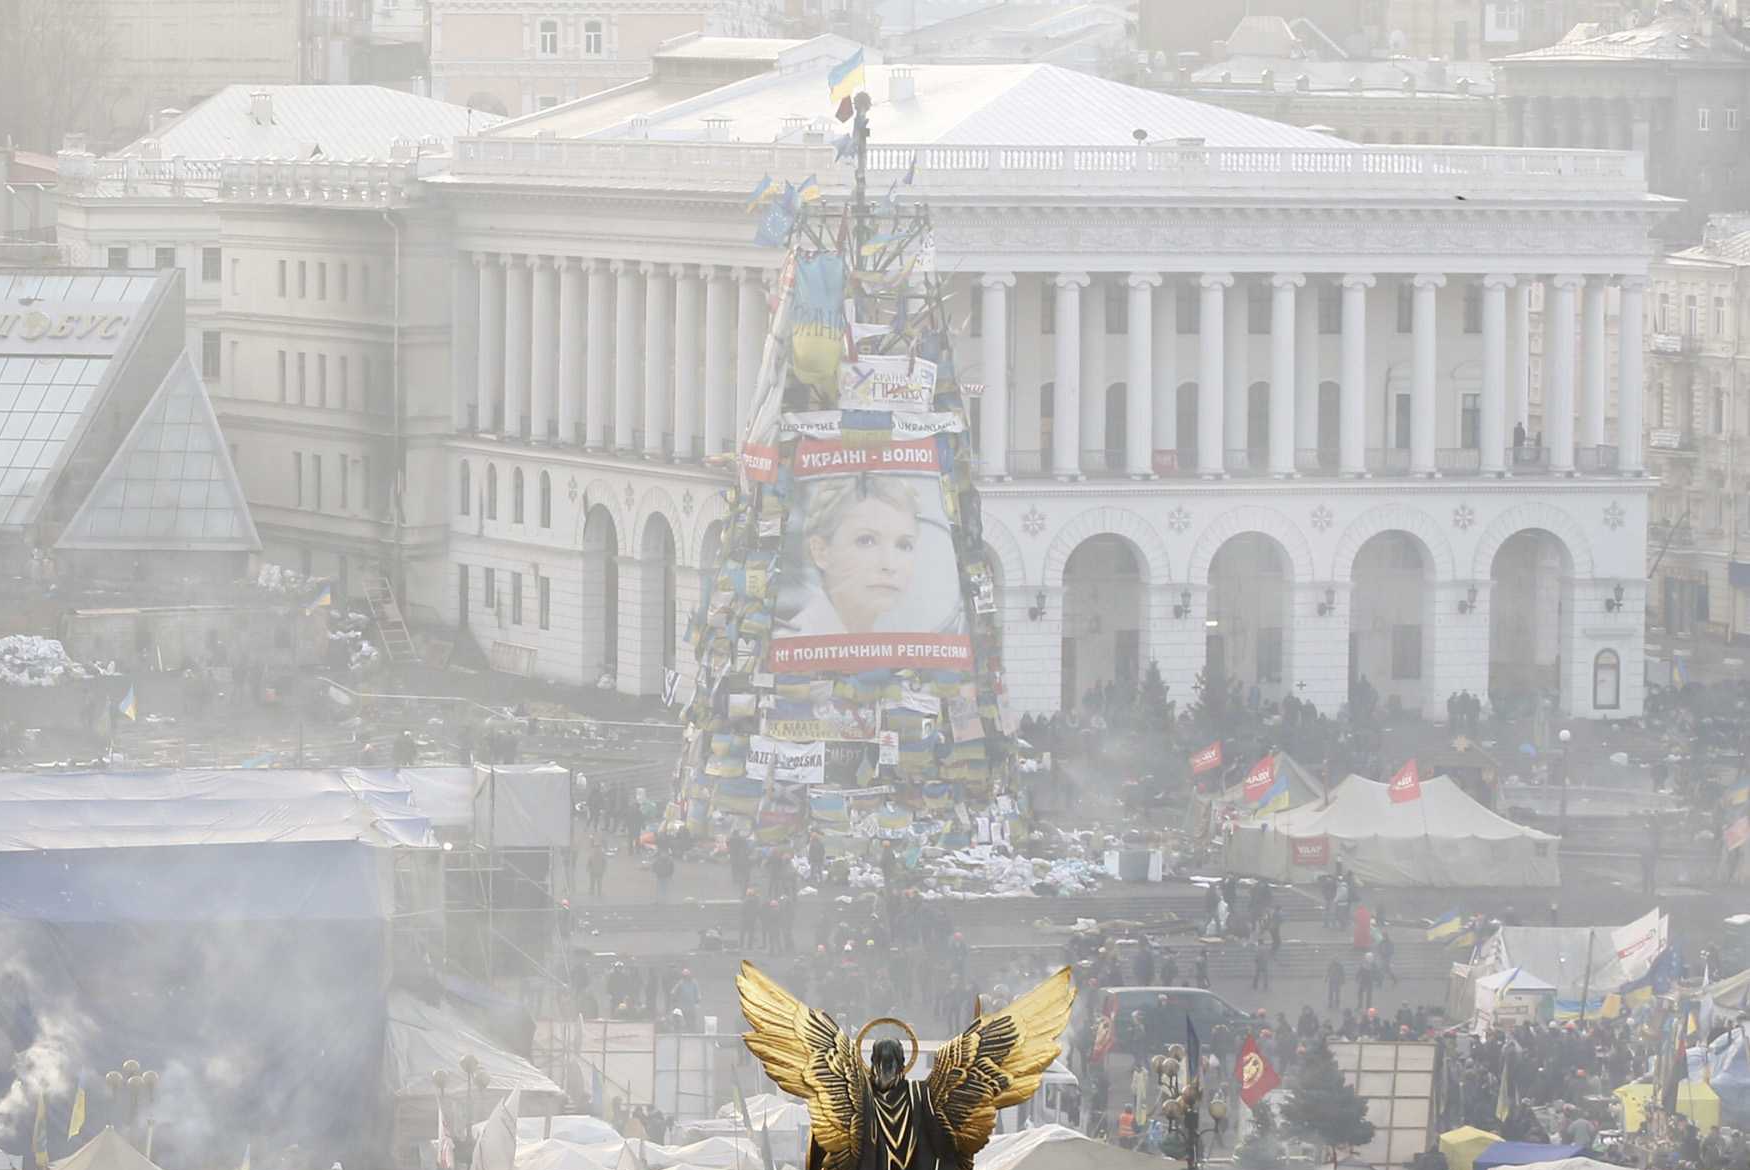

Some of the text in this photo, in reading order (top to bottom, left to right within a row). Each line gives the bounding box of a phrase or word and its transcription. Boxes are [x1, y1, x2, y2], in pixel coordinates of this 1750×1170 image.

[882, 447, 932, 464] ВОЛЮ!
[775, 644, 968, 662] НІ ПОЛІТИЧНИМ РЕПРЕСІЯМ
